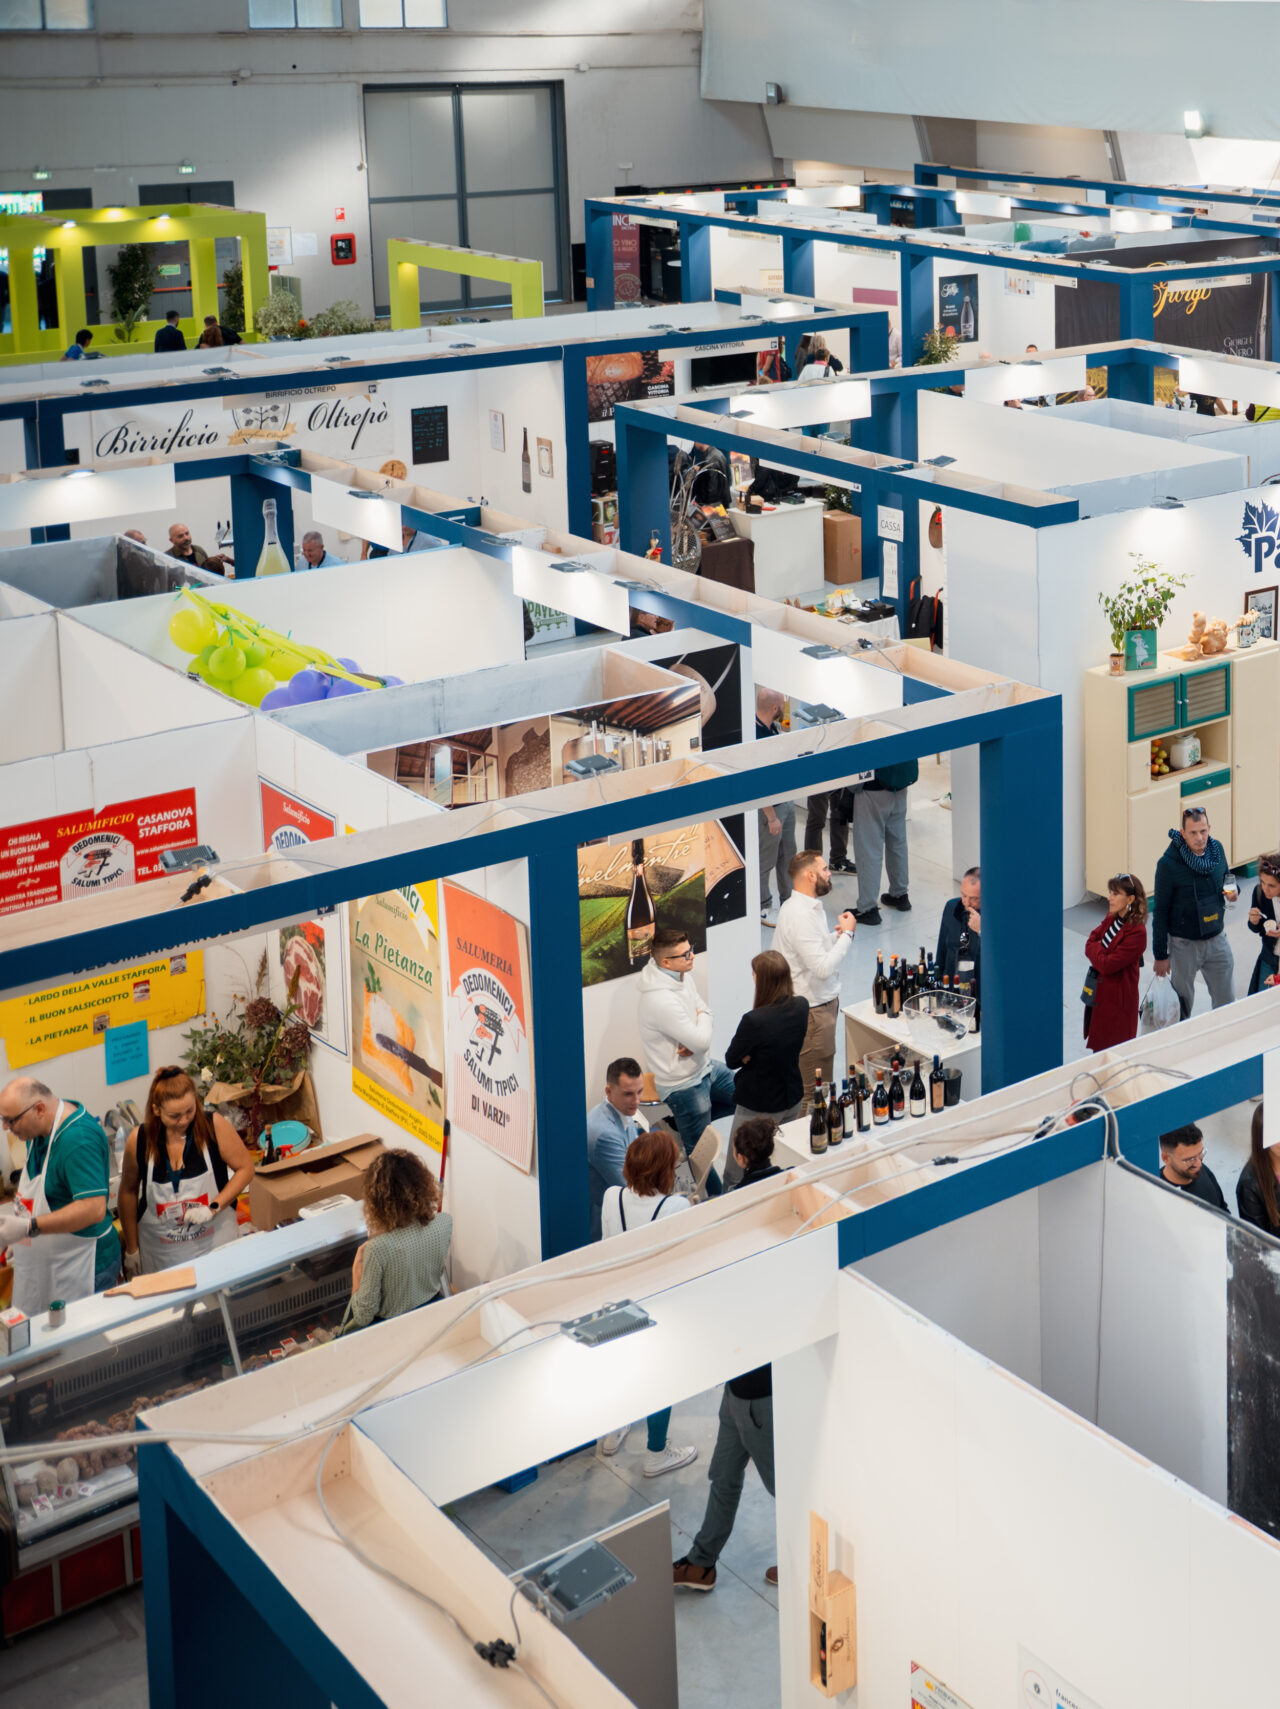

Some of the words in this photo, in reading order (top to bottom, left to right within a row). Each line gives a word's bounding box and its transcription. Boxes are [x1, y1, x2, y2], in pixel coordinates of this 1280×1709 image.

[720, 341, 745, 350] VITTORIA
[265, 388, 302, 399] BIRRIFICIO
[96, 408, 220, 458] Birrificio
[307, 397, 390, 451] Oltrepò
[880, 520, 901, 532] CASSA
[137, 806, 193, 825] CASANOVA
[282, 802, 311, 825] Salumificio
[57, 813, 134, 838] SALUMIFICIO
[139, 819, 190, 838] STAFFORA
[19, 832, 41, 843] REGALA
[72, 834, 120, 854] DEDOMENICI
[10, 846, 26, 856] BUON
[28, 841, 49, 852] SALAME
[71, 877, 100, 888] SALUMI
[103, 868, 124, 886] TIPICI
[137, 866, 152, 876] TEL.
[355, 920, 370, 949] La
[375, 931, 433, 987] Pietanza
[457, 937, 513, 977] SALUMERIA
[28, 991, 60, 1006] LARDO
[62, 983, 90, 997] DELLA
[92, 976, 120, 990] VALLE
[121, 963, 167, 982] STAFFORA
[462, 972, 513, 1016] DEDOMENICI
[29, 1014, 37, 1024] IL
[39, 1007, 66, 1022] BUON
[67, 991, 129, 1014] SALSICCIOTTO
[30, 1035, 42, 1046] LA
[44, 1023, 88, 1042] PIETANZA
[464, 1049, 493, 1095] SALUMI
[496, 1073, 519, 1097] TIPICI
[471, 1094, 480, 1113] DI
